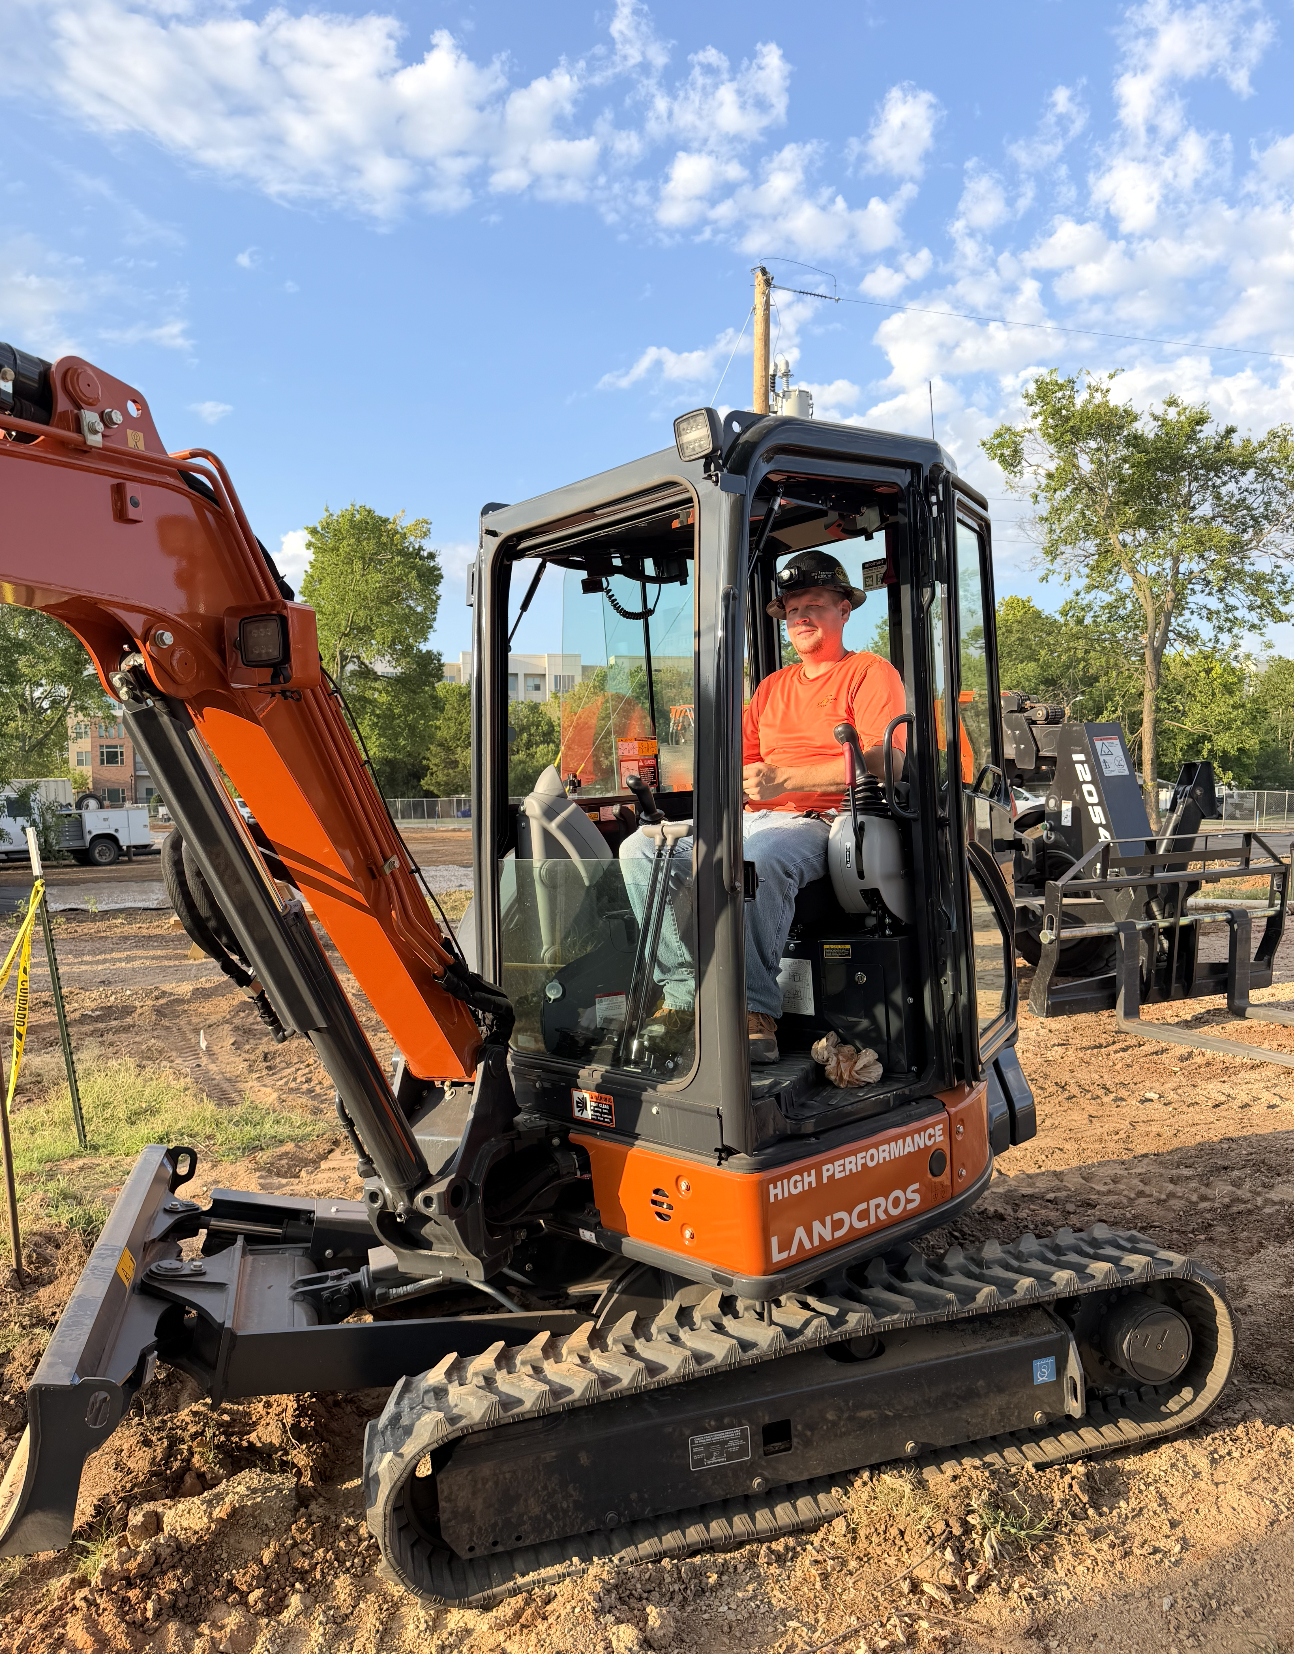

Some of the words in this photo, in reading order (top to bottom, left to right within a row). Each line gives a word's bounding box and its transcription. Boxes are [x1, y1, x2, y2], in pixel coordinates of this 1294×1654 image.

[16, 980, 28, 1027] CUIDADO
[769, 1169, 817, 1203] HIGH
[822, 1124, 944, 1184] PERFORMANCE
[771, 1182, 921, 1263] LANDCROS
